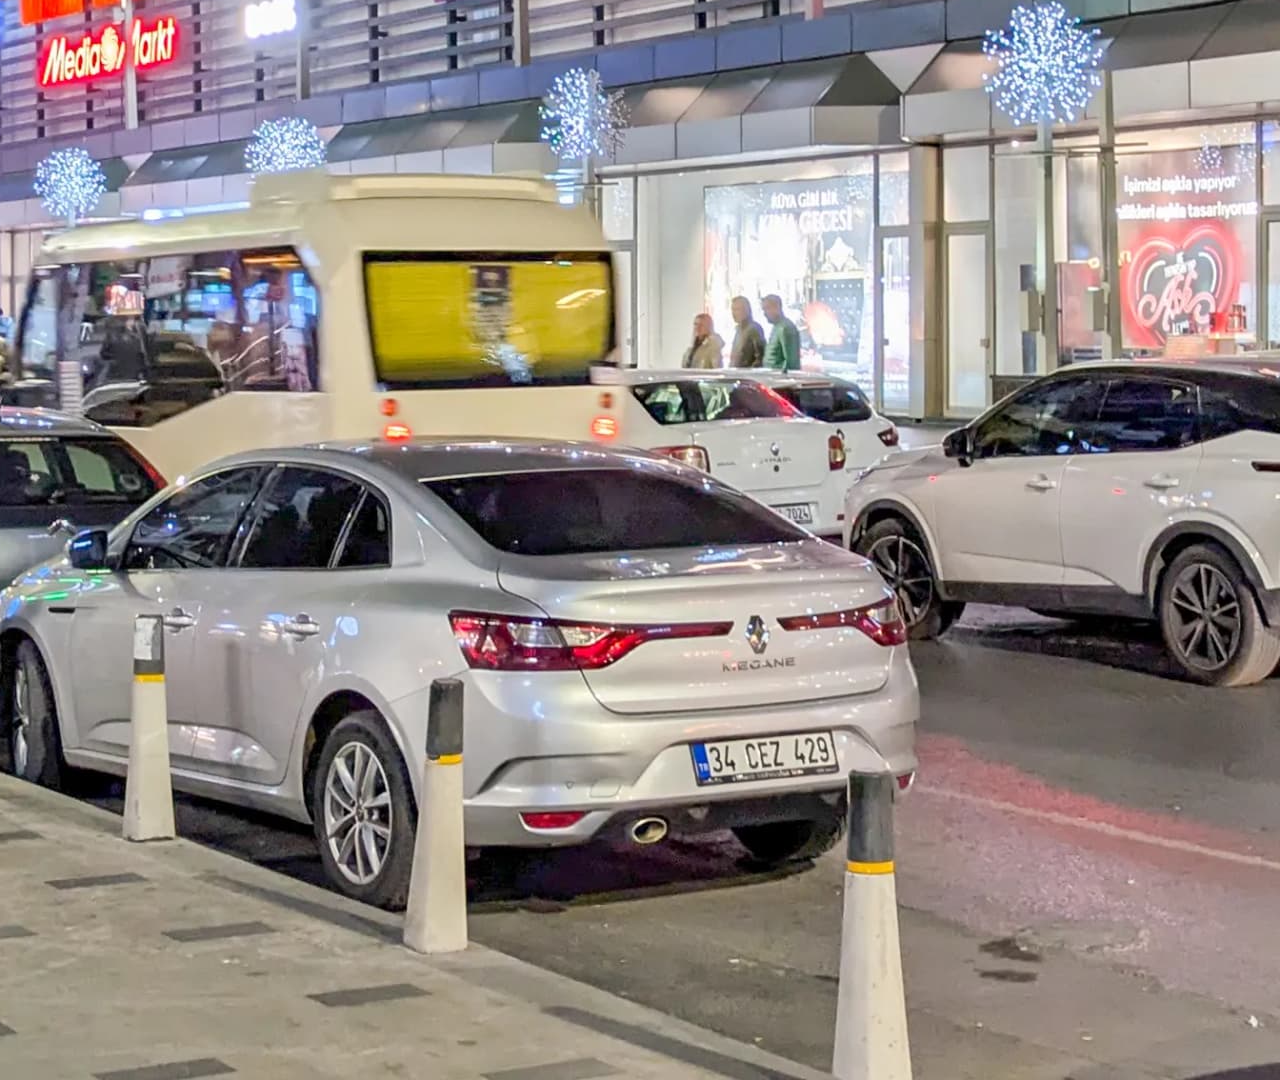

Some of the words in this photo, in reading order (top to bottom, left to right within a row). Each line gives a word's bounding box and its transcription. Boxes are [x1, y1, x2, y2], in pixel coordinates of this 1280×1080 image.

[722, 657, 796, 672] MEGANE
[709, 745, 736, 773] 34
[745, 741, 784, 769] CEZ
[794, 737, 830, 765] 429
